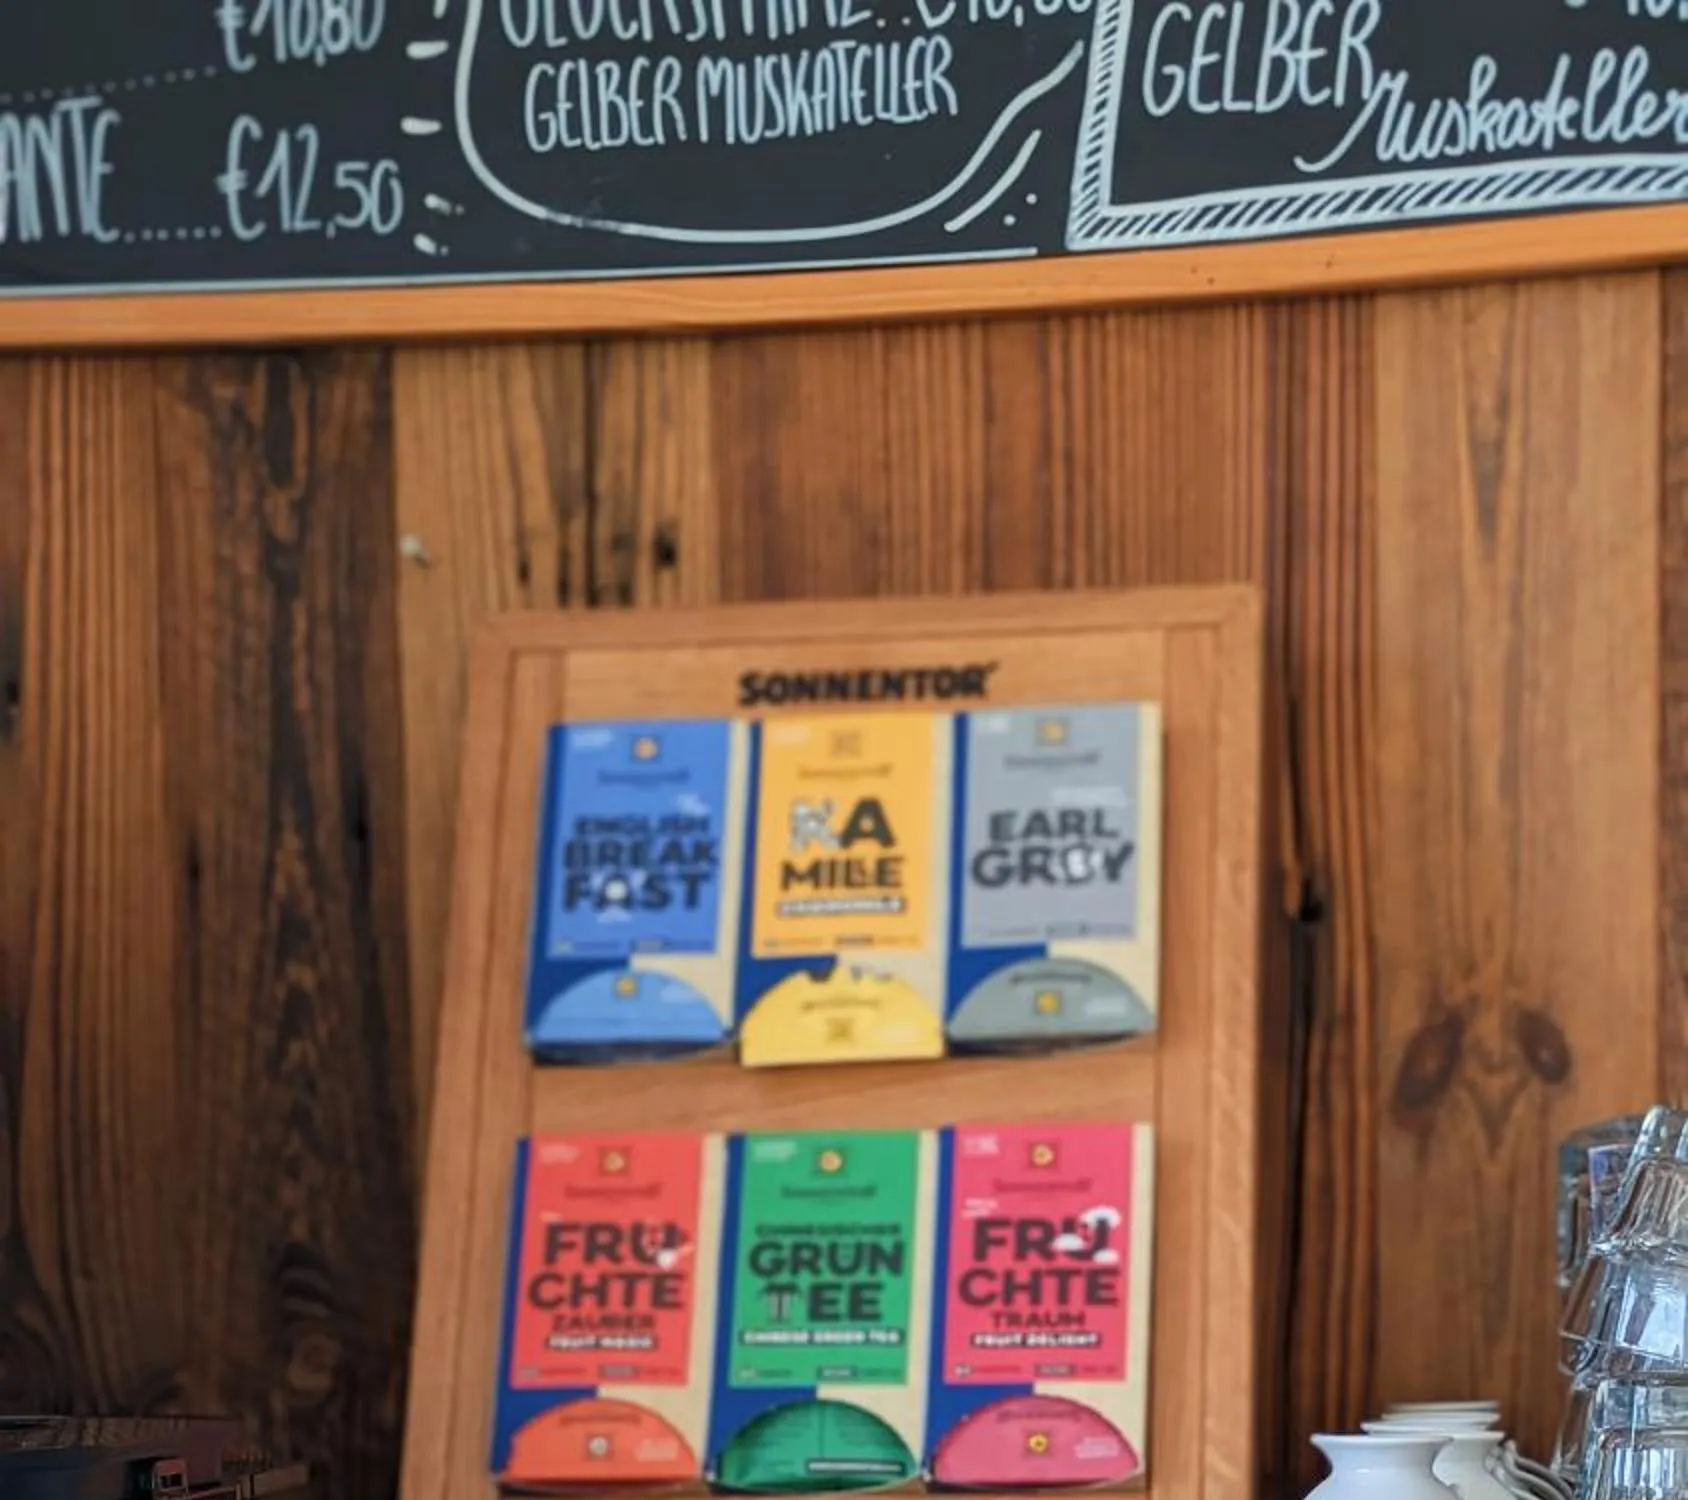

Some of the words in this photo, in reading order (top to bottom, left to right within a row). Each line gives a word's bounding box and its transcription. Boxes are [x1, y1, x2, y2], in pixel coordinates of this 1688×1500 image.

[1142, 0, 1382, 116] GELBER
[523, 55, 688, 153] GELBER
[696, 34, 959, 145] MUSKATELLER
[215, 115, 404, 241] €12,50
[738, 662, 990, 707] SONNENTOR
[788, 796, 896, 852] KA
[988, 808, 1121, 843] EARL
[562, 836, 721, 870] BREAK
[779, 853, 906, 892] MILE
[528, 1271, 688, 1312] CHTE
[762, 1281, 886, 1325] TEE
[958, 1266, 1121, 1308] CHTE
